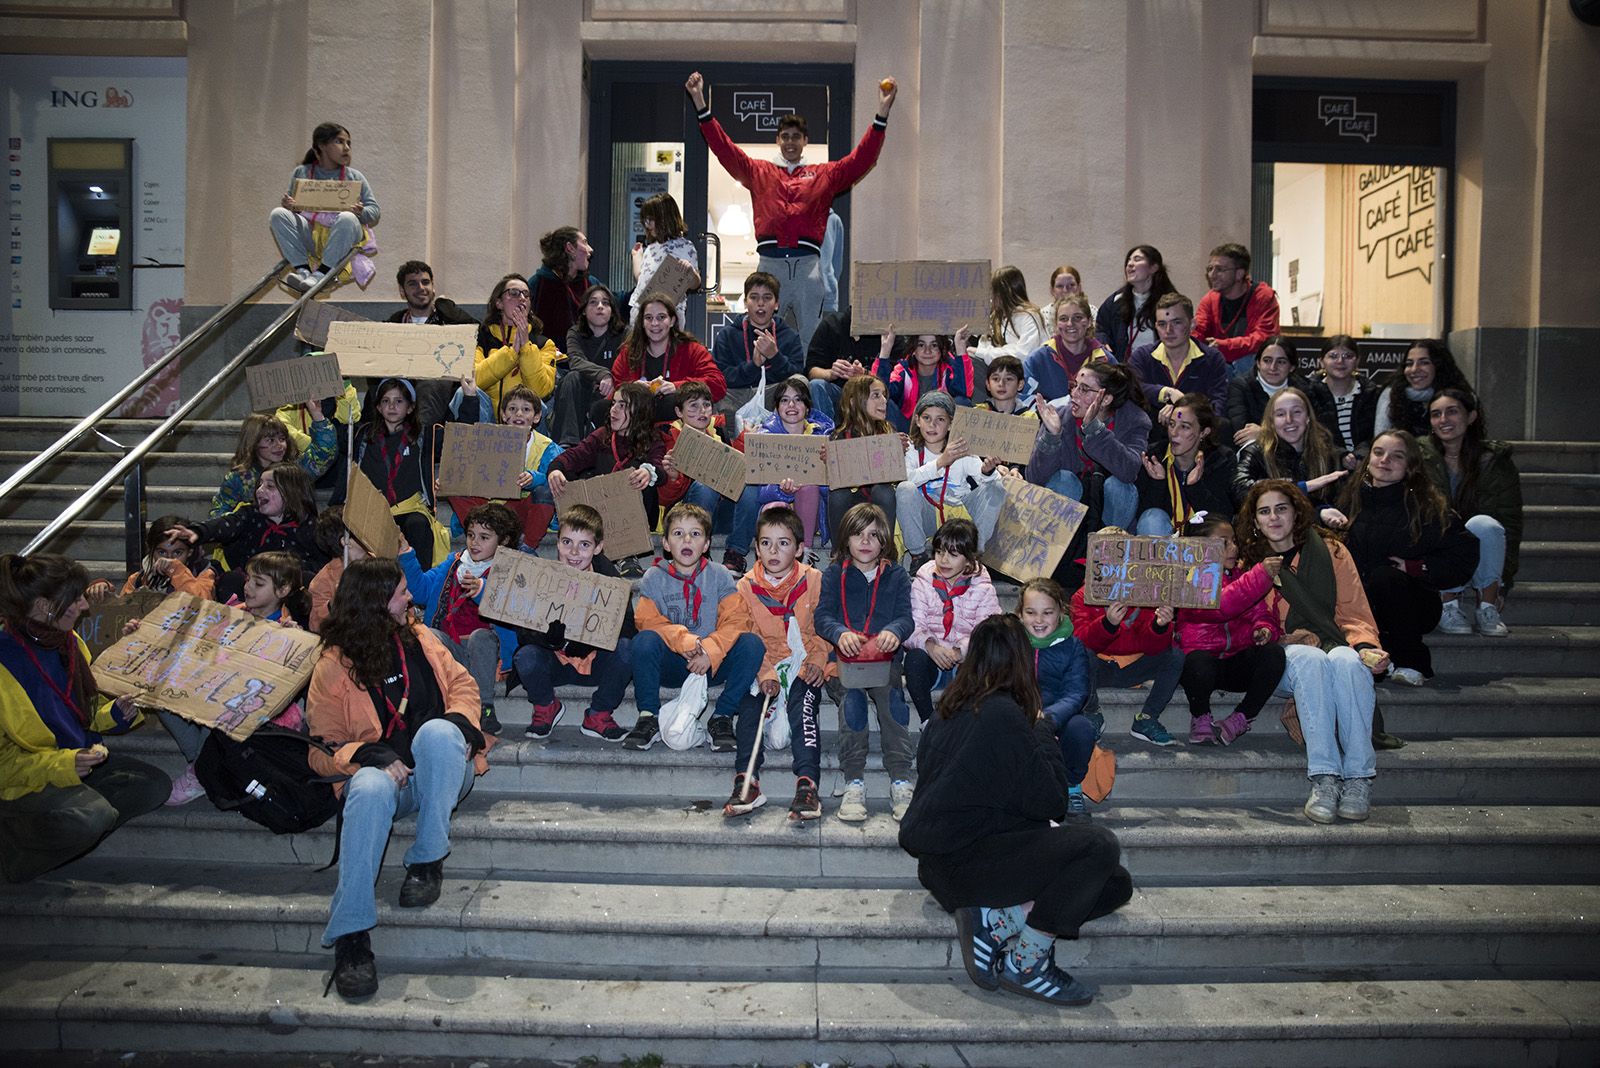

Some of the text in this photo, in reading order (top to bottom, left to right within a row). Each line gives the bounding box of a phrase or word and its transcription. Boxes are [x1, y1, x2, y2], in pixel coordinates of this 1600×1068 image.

[51, 90, 98, 108] ING
[740, 99, 766, 111] CAFÉ
[1324, 102, 1350, 115] CAFÉ
[1345, 119, 1370, 132] CAFÉ
[1366, 189, 1401, 230] CAFÉ
[1395, 218, 1435, 260] CAFÉ
[45, 334, 73, 343] puedes
[12, 373, 37, 381] també
[81, 374, 105, 382] diners
